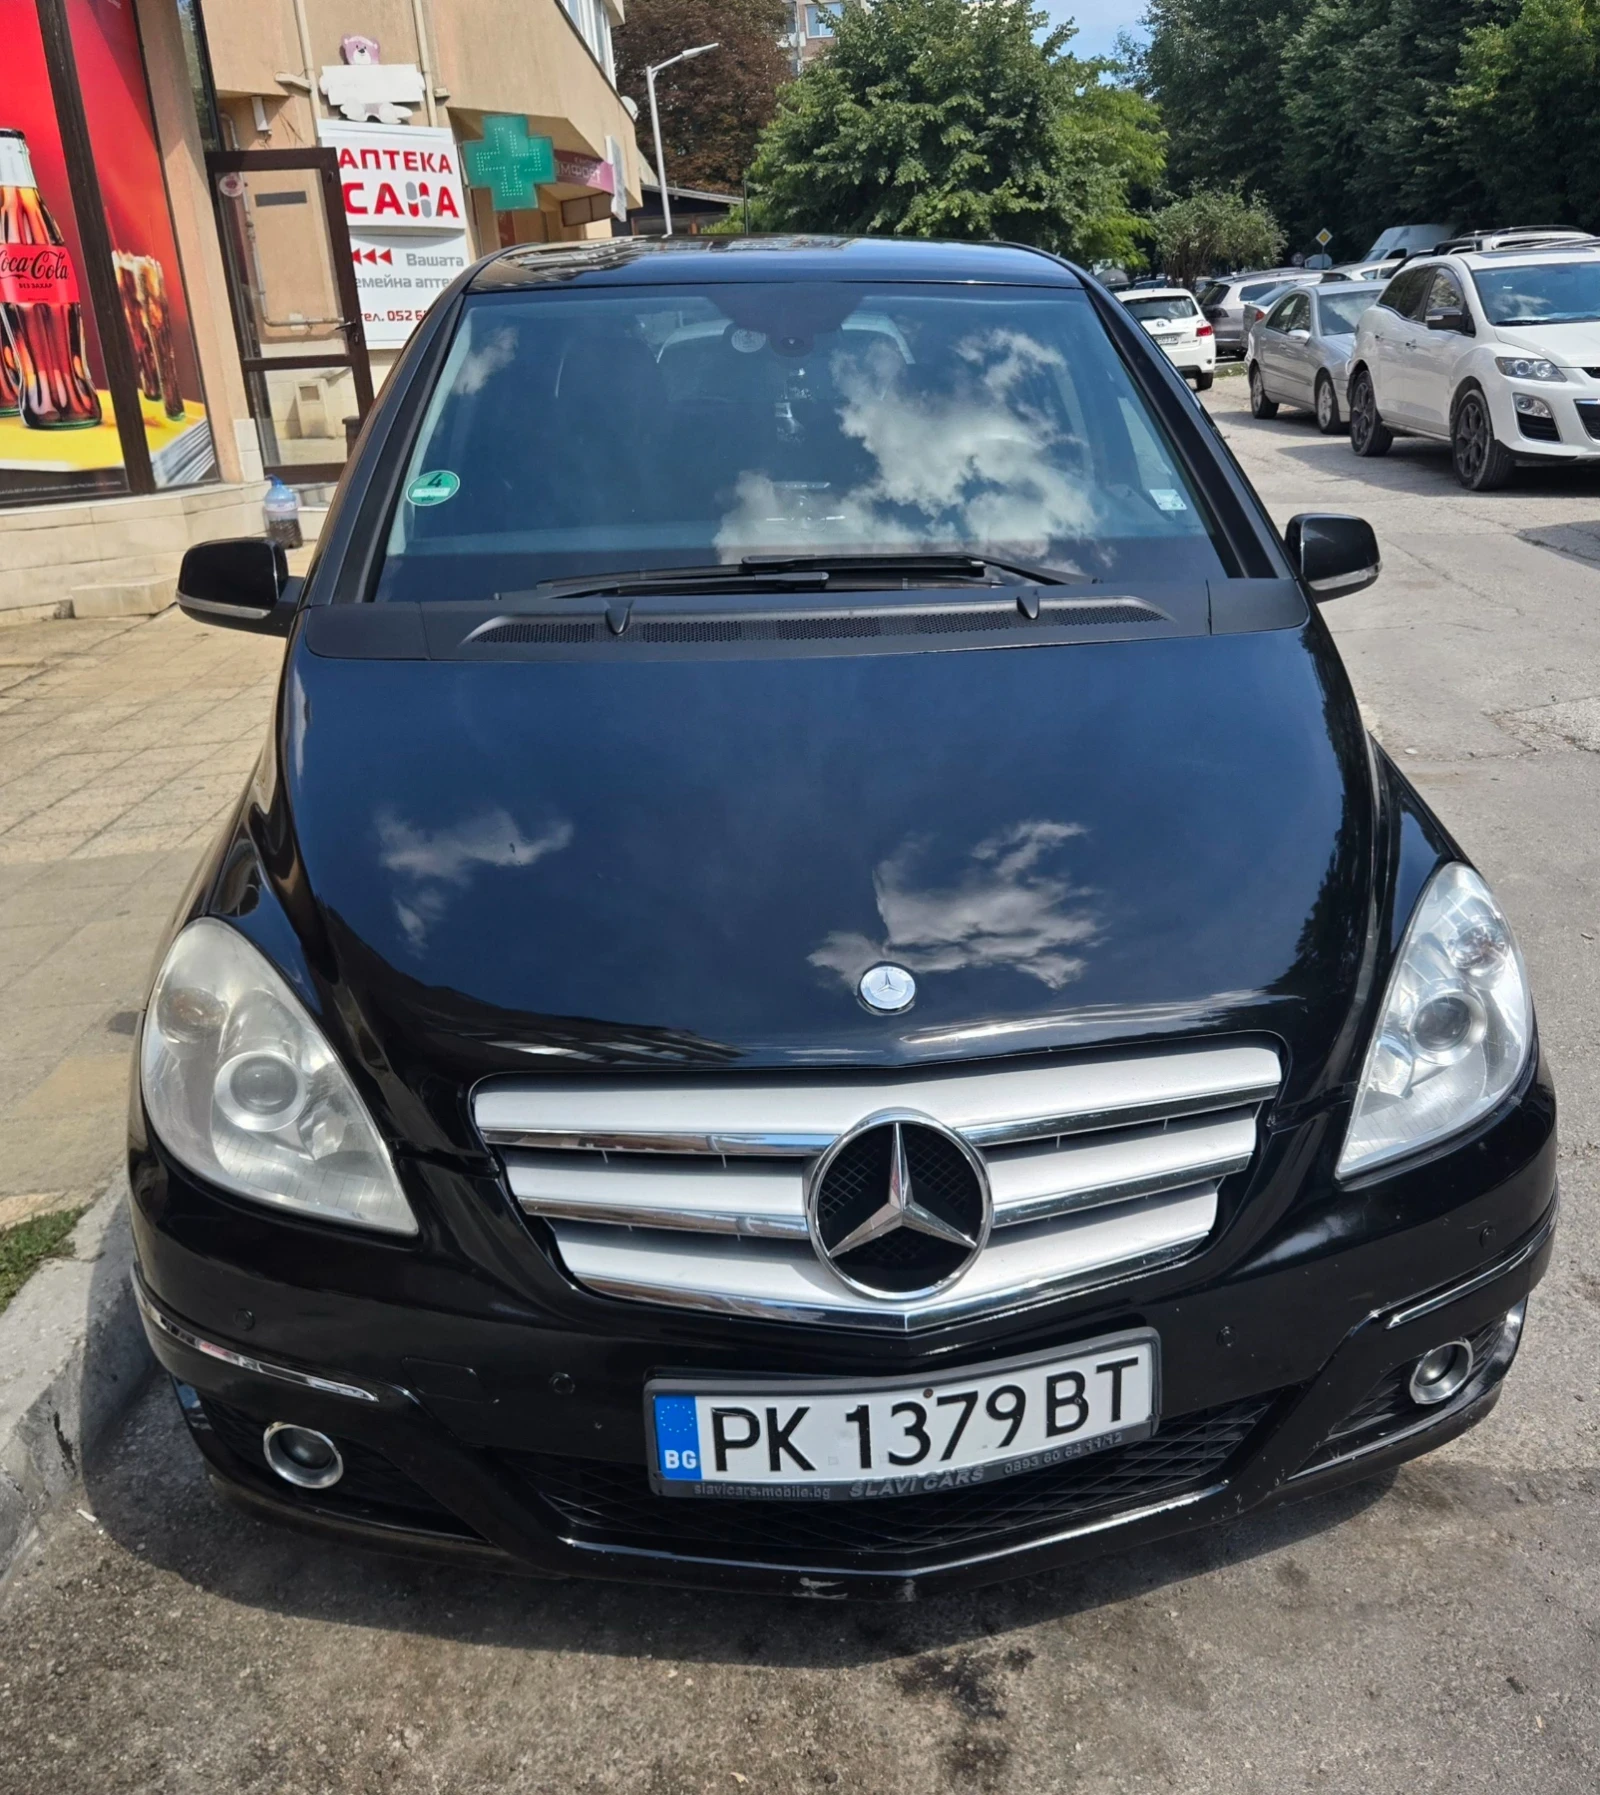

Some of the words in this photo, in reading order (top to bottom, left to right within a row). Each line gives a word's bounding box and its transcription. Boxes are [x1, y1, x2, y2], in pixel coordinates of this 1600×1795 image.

[338, 147, 453, 174] АПТЕКА
[342, 181, 460, 218] САНА
[406, 253, 464, 266] Вашата
[356, 274, 412, 288] емейна
[415, 277, 453, 288] апте
[387, 310, 413, 321] 052
[415, 310, 428, 321] 6
[427, 473, 443, 487] 4
[711, 1406, 816, 1472] PK
[845, 1384, 1027, 1470] 1379
[1046, 1356, 1139, 1438] BT
[664, 1450, 697, 1469] BG
[1004, 1456, 1039, 1474] 0893
[850, 1477, 917, 1498] SLAVI
[923, 1466, 985, 1491] CARS
[694, 1483, 831, 1500] slavicars.mobile.bg
